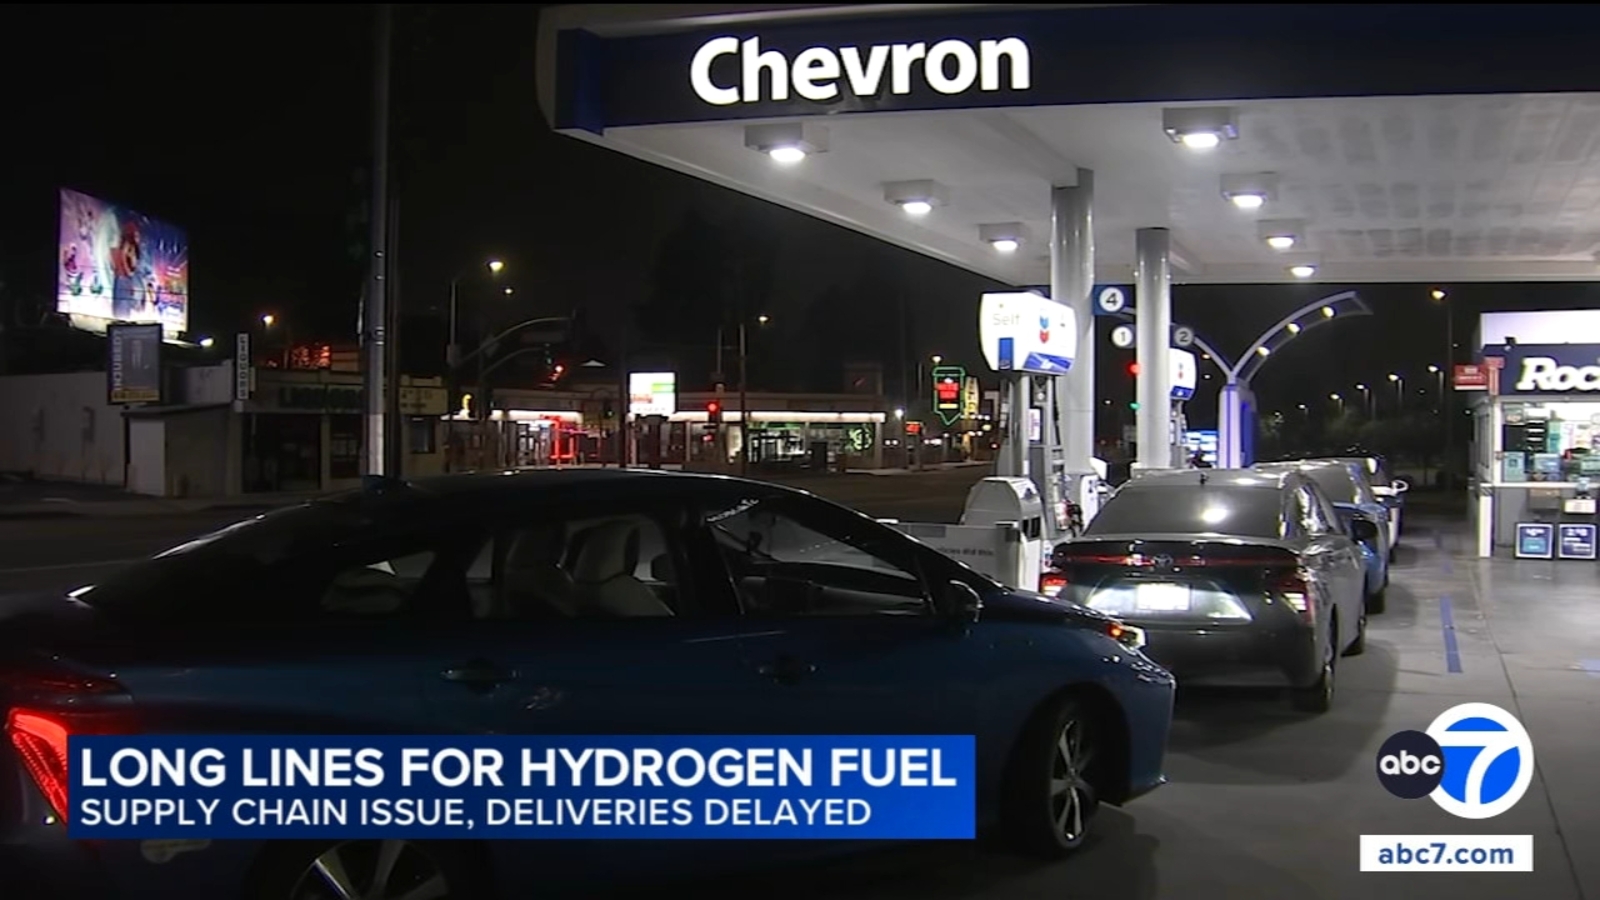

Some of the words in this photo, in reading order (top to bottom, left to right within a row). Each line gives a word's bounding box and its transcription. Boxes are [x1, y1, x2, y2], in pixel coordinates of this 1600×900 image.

[690, 36, 1031, 105] Chevron
[1106, 292, 1118, 306] 4
[993, 313, 1020, 326] Self
[1120, 331, 1126, 342] 1
[1179, 331, 1189, 342] 2
[1515, 356, 1600, 391] Roc
